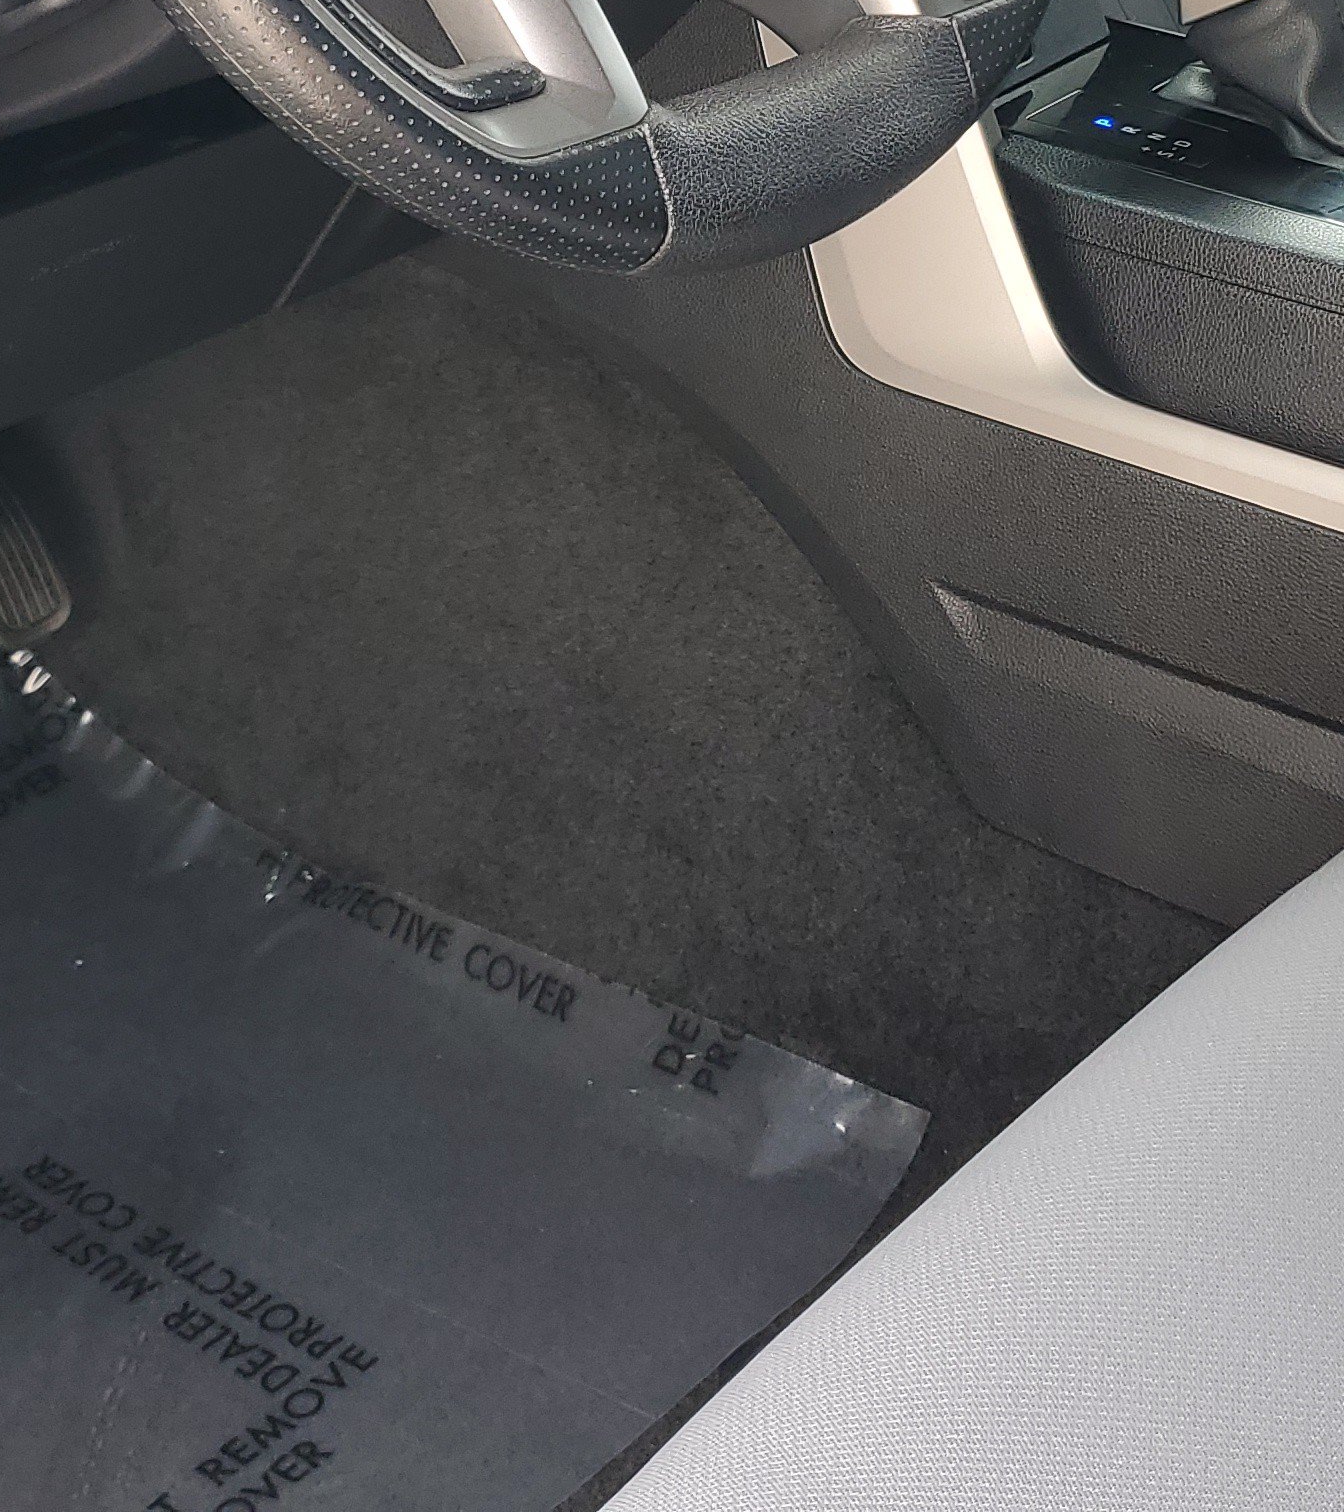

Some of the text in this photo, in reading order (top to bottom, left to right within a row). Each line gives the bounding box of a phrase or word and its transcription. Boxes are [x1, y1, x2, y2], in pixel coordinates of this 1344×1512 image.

[1121, 126, 1141, 135] R
[463, 943, 580, 1024] COVER
[22, 1153, 344, 1362] PROTECTIVE COVER
[51, 1230, 163, 1305] MUST
[163, 1300, 302, 1397] DEALER
[194, 1332, 380, 1488] REMOVE
[213, 1439, 337, 1512] OVER
